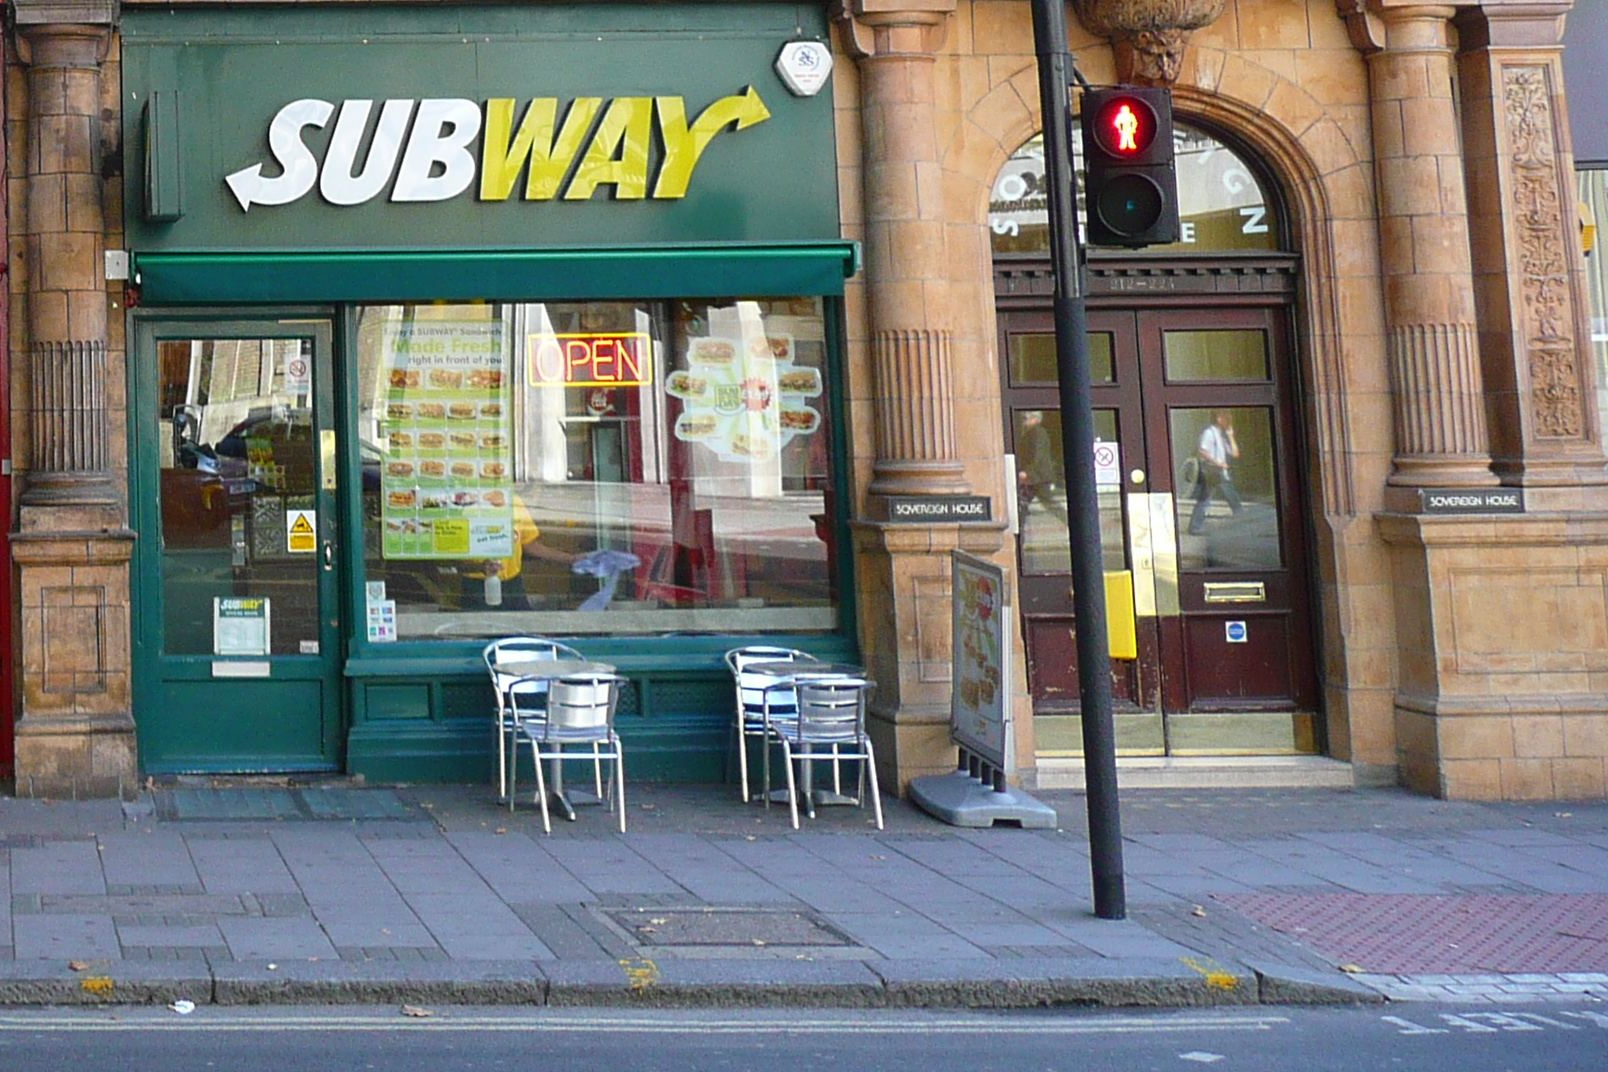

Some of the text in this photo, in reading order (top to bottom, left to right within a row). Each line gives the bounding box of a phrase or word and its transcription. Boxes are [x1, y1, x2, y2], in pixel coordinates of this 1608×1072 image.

[225, 83, 771, 212] SUBWAY
[391, 337, 502, 353] Made Fresh
[408, 355, 431, 366] right
[433, 355, 443, 364] in
[446, 354, 471, 364] front
[473, 354, 483, 364] of
[536, 339, 642, 382] OPEN
[1430, 495, 1519, 507] SOVEREIGN HOUSE
[896, 503, 983, 515] SOVEREIGN HOUSE
[221, 599, 264, 610] SUBWAY
